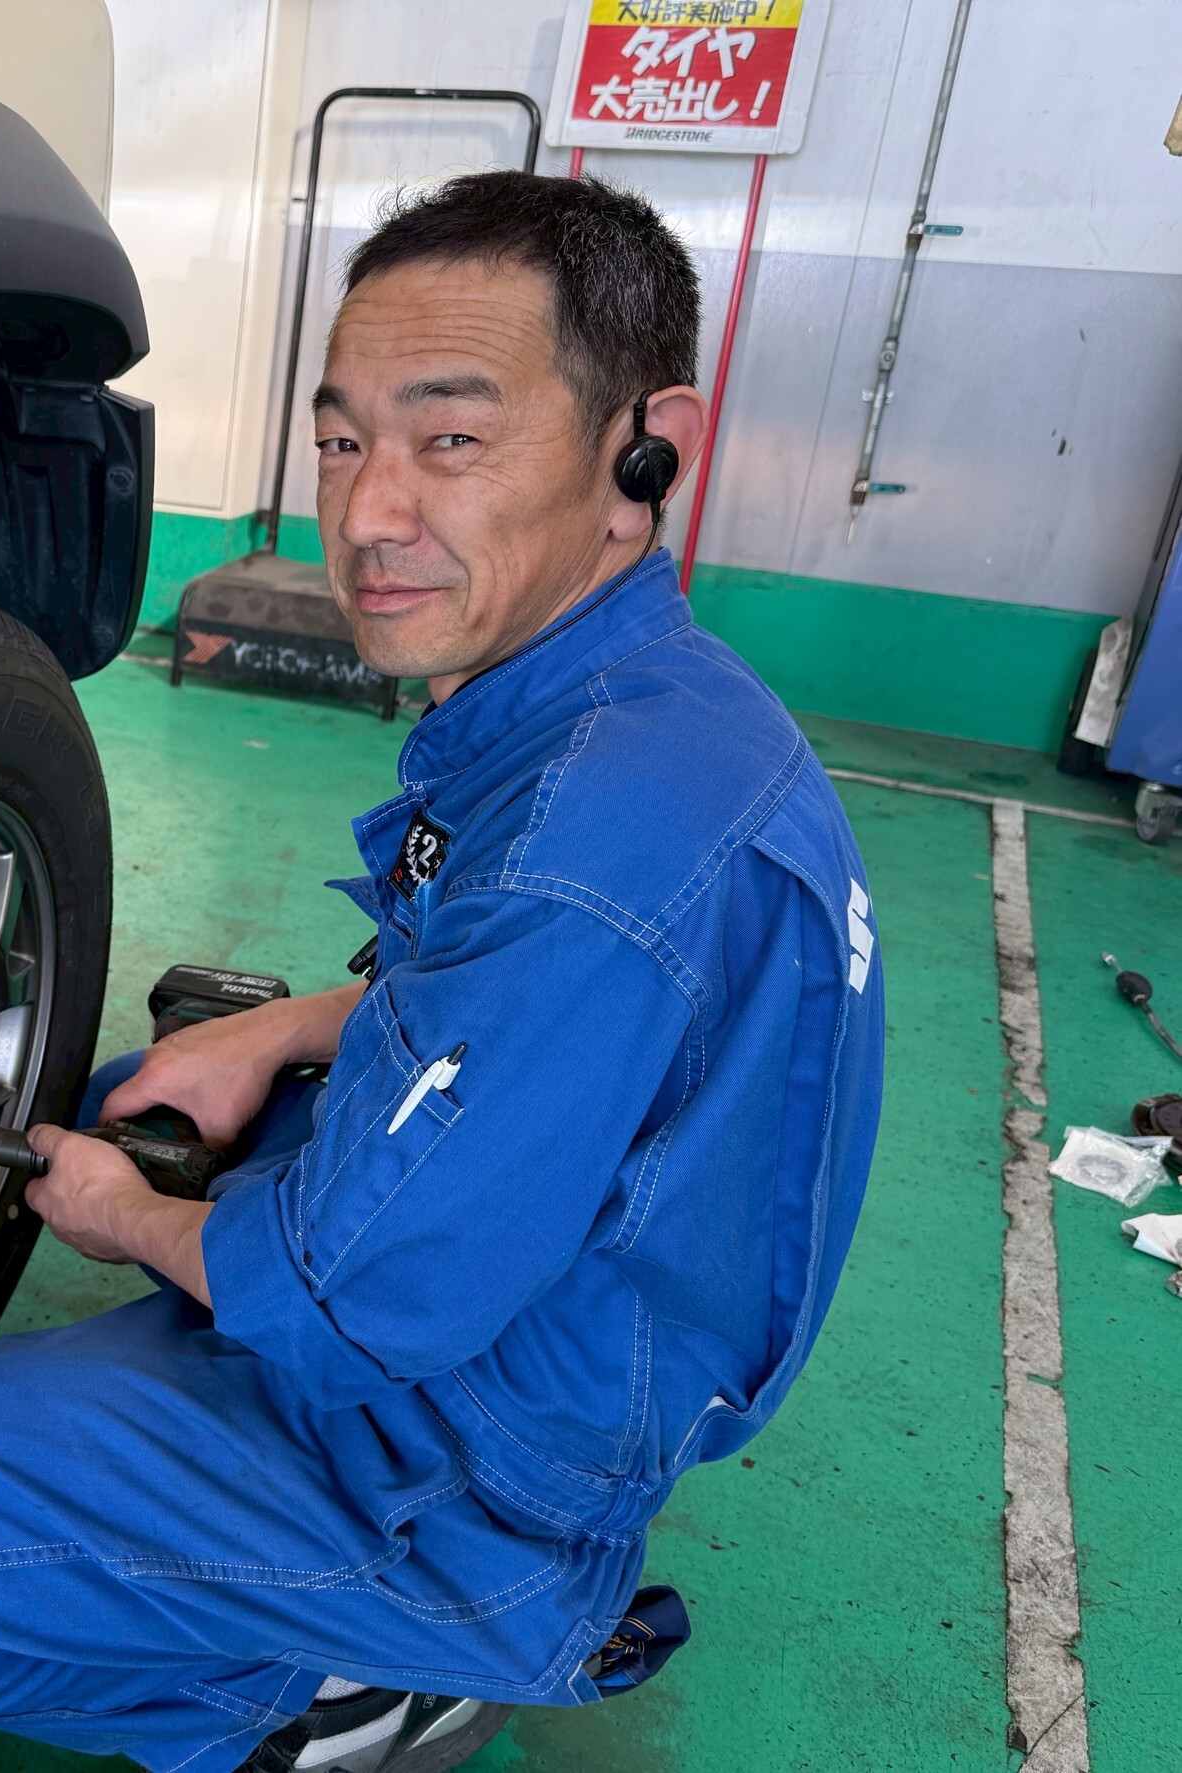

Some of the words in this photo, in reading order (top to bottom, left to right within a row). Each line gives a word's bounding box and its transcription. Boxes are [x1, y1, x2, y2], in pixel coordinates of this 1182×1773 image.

[621, 26, 756, 78] タイヤ
[588, 75, 771, 122] 大売出し！
[624, 126, 714, 143] BRIDGESTONE
[220, 983, 274, 999] makita
